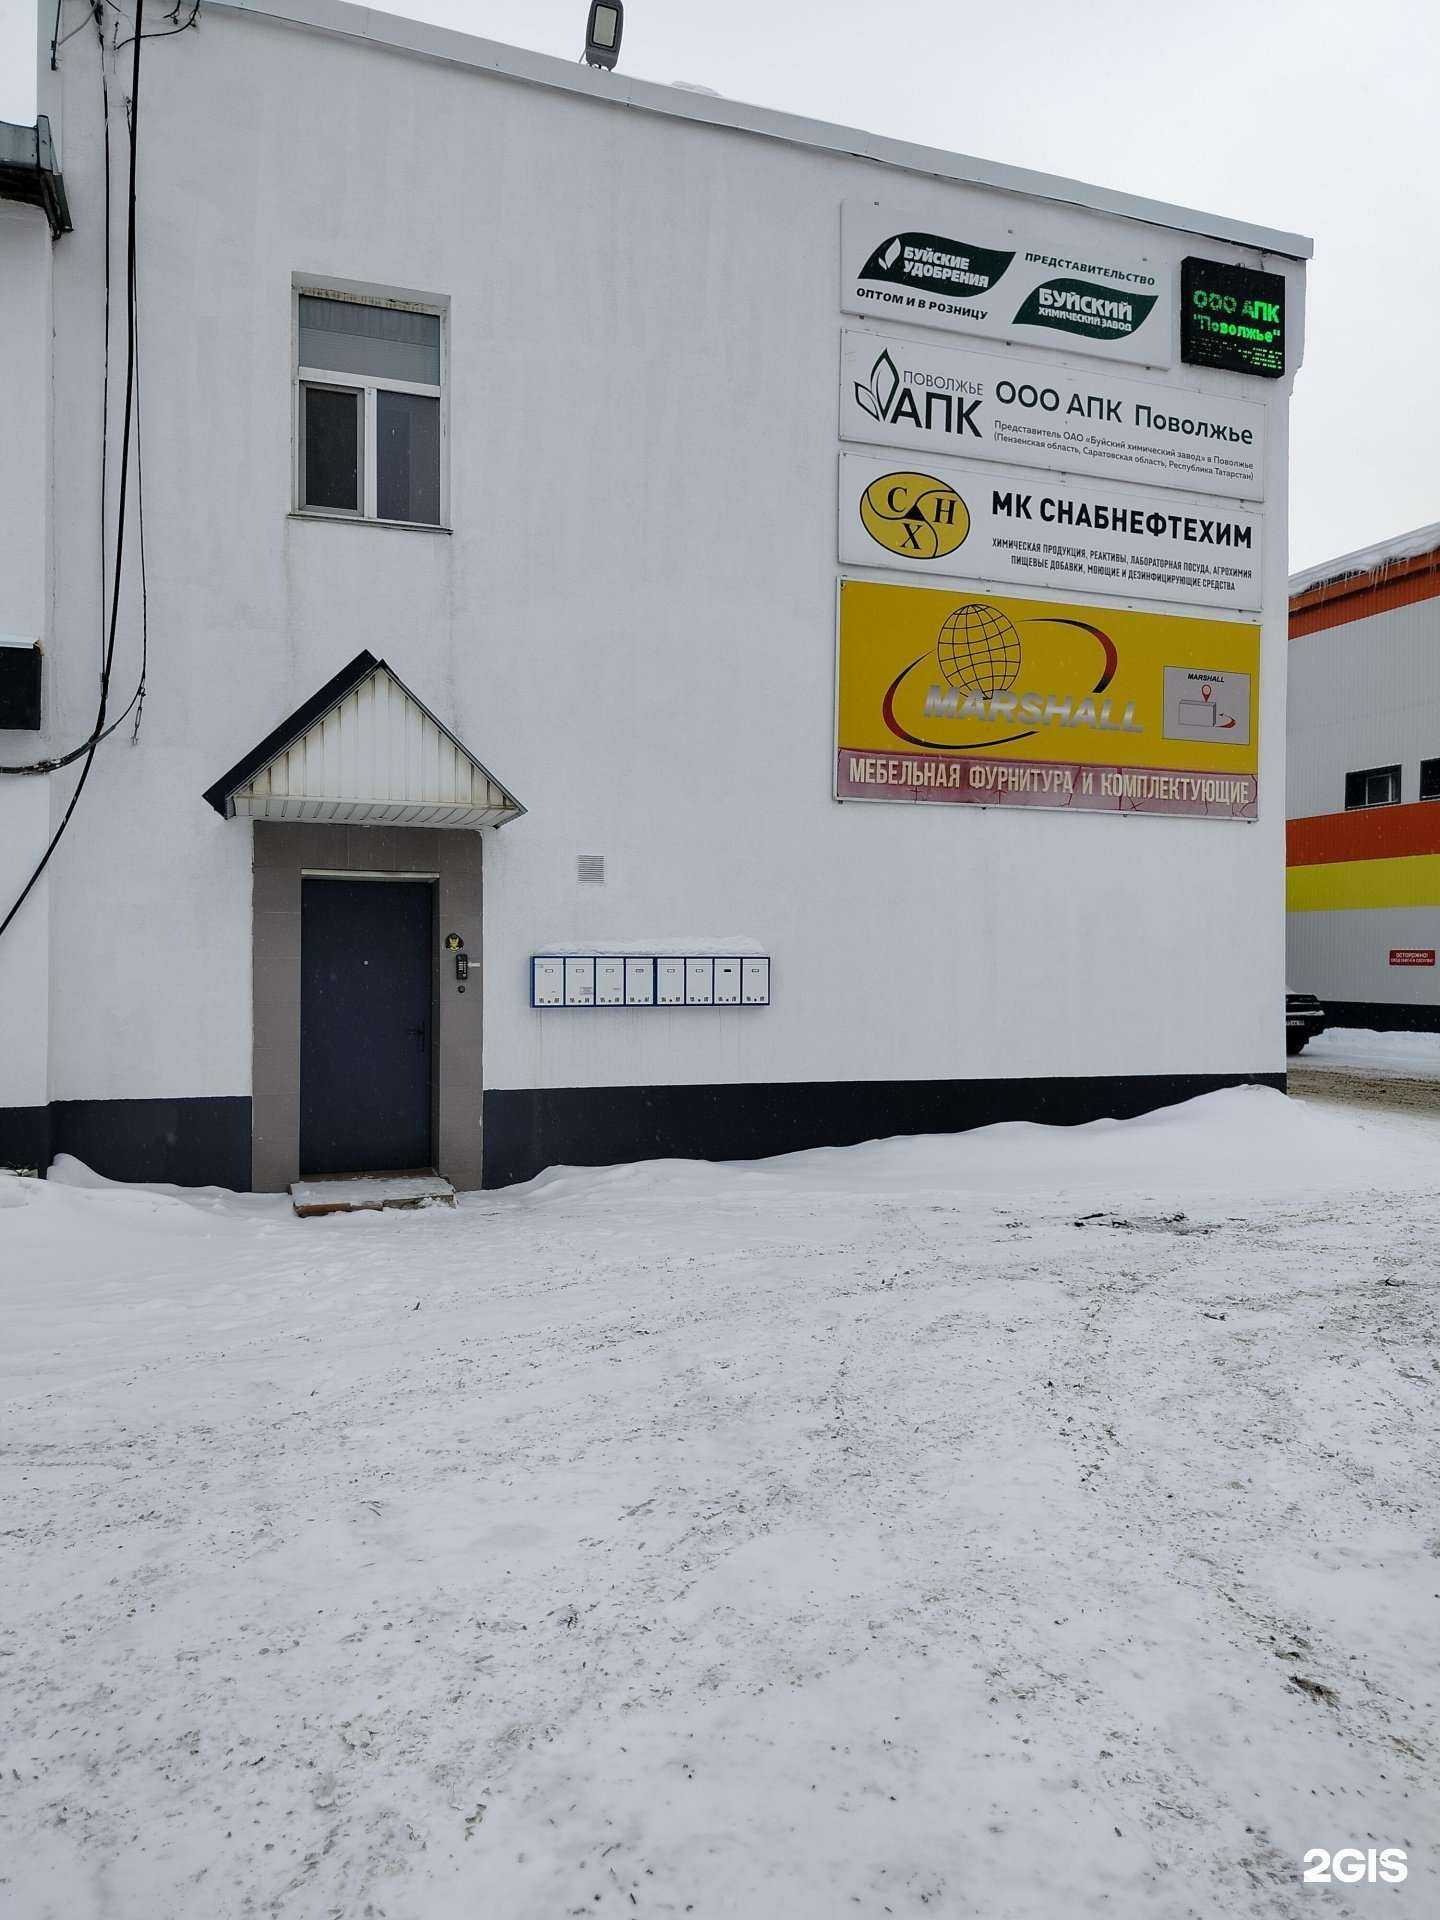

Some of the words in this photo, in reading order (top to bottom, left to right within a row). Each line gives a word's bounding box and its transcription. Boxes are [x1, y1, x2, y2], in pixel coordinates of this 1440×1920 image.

[903, 246, 970, 270] БУЙСКИЕ
[903, 260, 989, 288] УДОБРЕНИЯ
[1025, 252, 1155, 286] ПРЕДСТАВИТЕЛЬСТВО
[856, 288, 904, 305] ОПТОМ
[906, 297, 915, 307] И
[918, 299, 926, 309] В
[928, 301, 988, 320] РОЗНИЦУ
[1038, 306, 1100, 325] ХИМИЧЕСКИЙ
[1101, 319, 1132, 331] ЗАВОД
[1039, 287, 1132, 321] БУЙСКИЙ
[1193, 290, 1237, 313] ООО
[1242, 300, 1279, 323] АПК
[903, 370, 984, 396] ПОВОЛЖЬЕ
[890, 387, 983, 438] АПК
[996, 381, 1060, 411] ООО
[1066, 393, 1122, 423] АПК
[1135, 404, 1253, 445] Поволжье
[994, 420, 1061, 439] Представитель
[1063, 431, 1084, 442] ОАО
[1085, 435, 1126, 450] «Буйский
[1127, 444, 1175, 457] химический
[1177, 451, 1205, 462] завод»
[1213, 456, 1254, 469] Поволжье
[994, 431, 1045, 448] (Пензенская
[1046, 442, 1081, 454] область,
[1082, 446, 1133, 462] Саратовская
[1134, 456, 1167, 468] область,
[1168, 460, 1213, 475] Республика
[1214, 467, 1254, 480] Татарстан)
[887, 487, 908, 513] С
[933, 498, 957, 525] Н
[992, 490, 1032, 519] МК
[1040, 498, 1252, 549] СНАБНЕФТЕХИМ
[900, 523, 922, 550] Х
[992, 538, 1041, 552] ХИМИЧЕСКАЯ
[1042, 544, 1088, 559] ПРОДУКЦИЯ,
[1090, 550, 1128, 565] РЕАКТИВЫ,
[1130, 555, 1182, 570] ЛАБОРАТОРНАЯ
[1183, 562, 1211, 575] ПОСУДА,
[1213, 566, 1252, 579] АГРОХИМИЯ
[1011, 555, 1048, 568] ПИЩЕВЫЕ
[1050, 560, 1086, 574] ДОБАВКИ,
[1087, 564, 1120, 578] МОЮЩИЕ
[1121, 569, 1127, 579] И
[1128, 570, 1201, 587] ДЕЗИНФИЦИРУЮЩИЕ
[1202, 578, 1235, 591] СРЕДСТВА
[1187, 673, 1225, 683] MARSHALL
[922, 684, 1144, 733] MARSHALL
[850, 758, 960, 788] МЕБЕЛЬНАЯ
[969, 764, 1074, 793] ФУРНИТУРА
[1082, 772, 1093, 795] И
[1101, 771, 1249, 804] КОМПЛЕКТУЮЩИЕ
